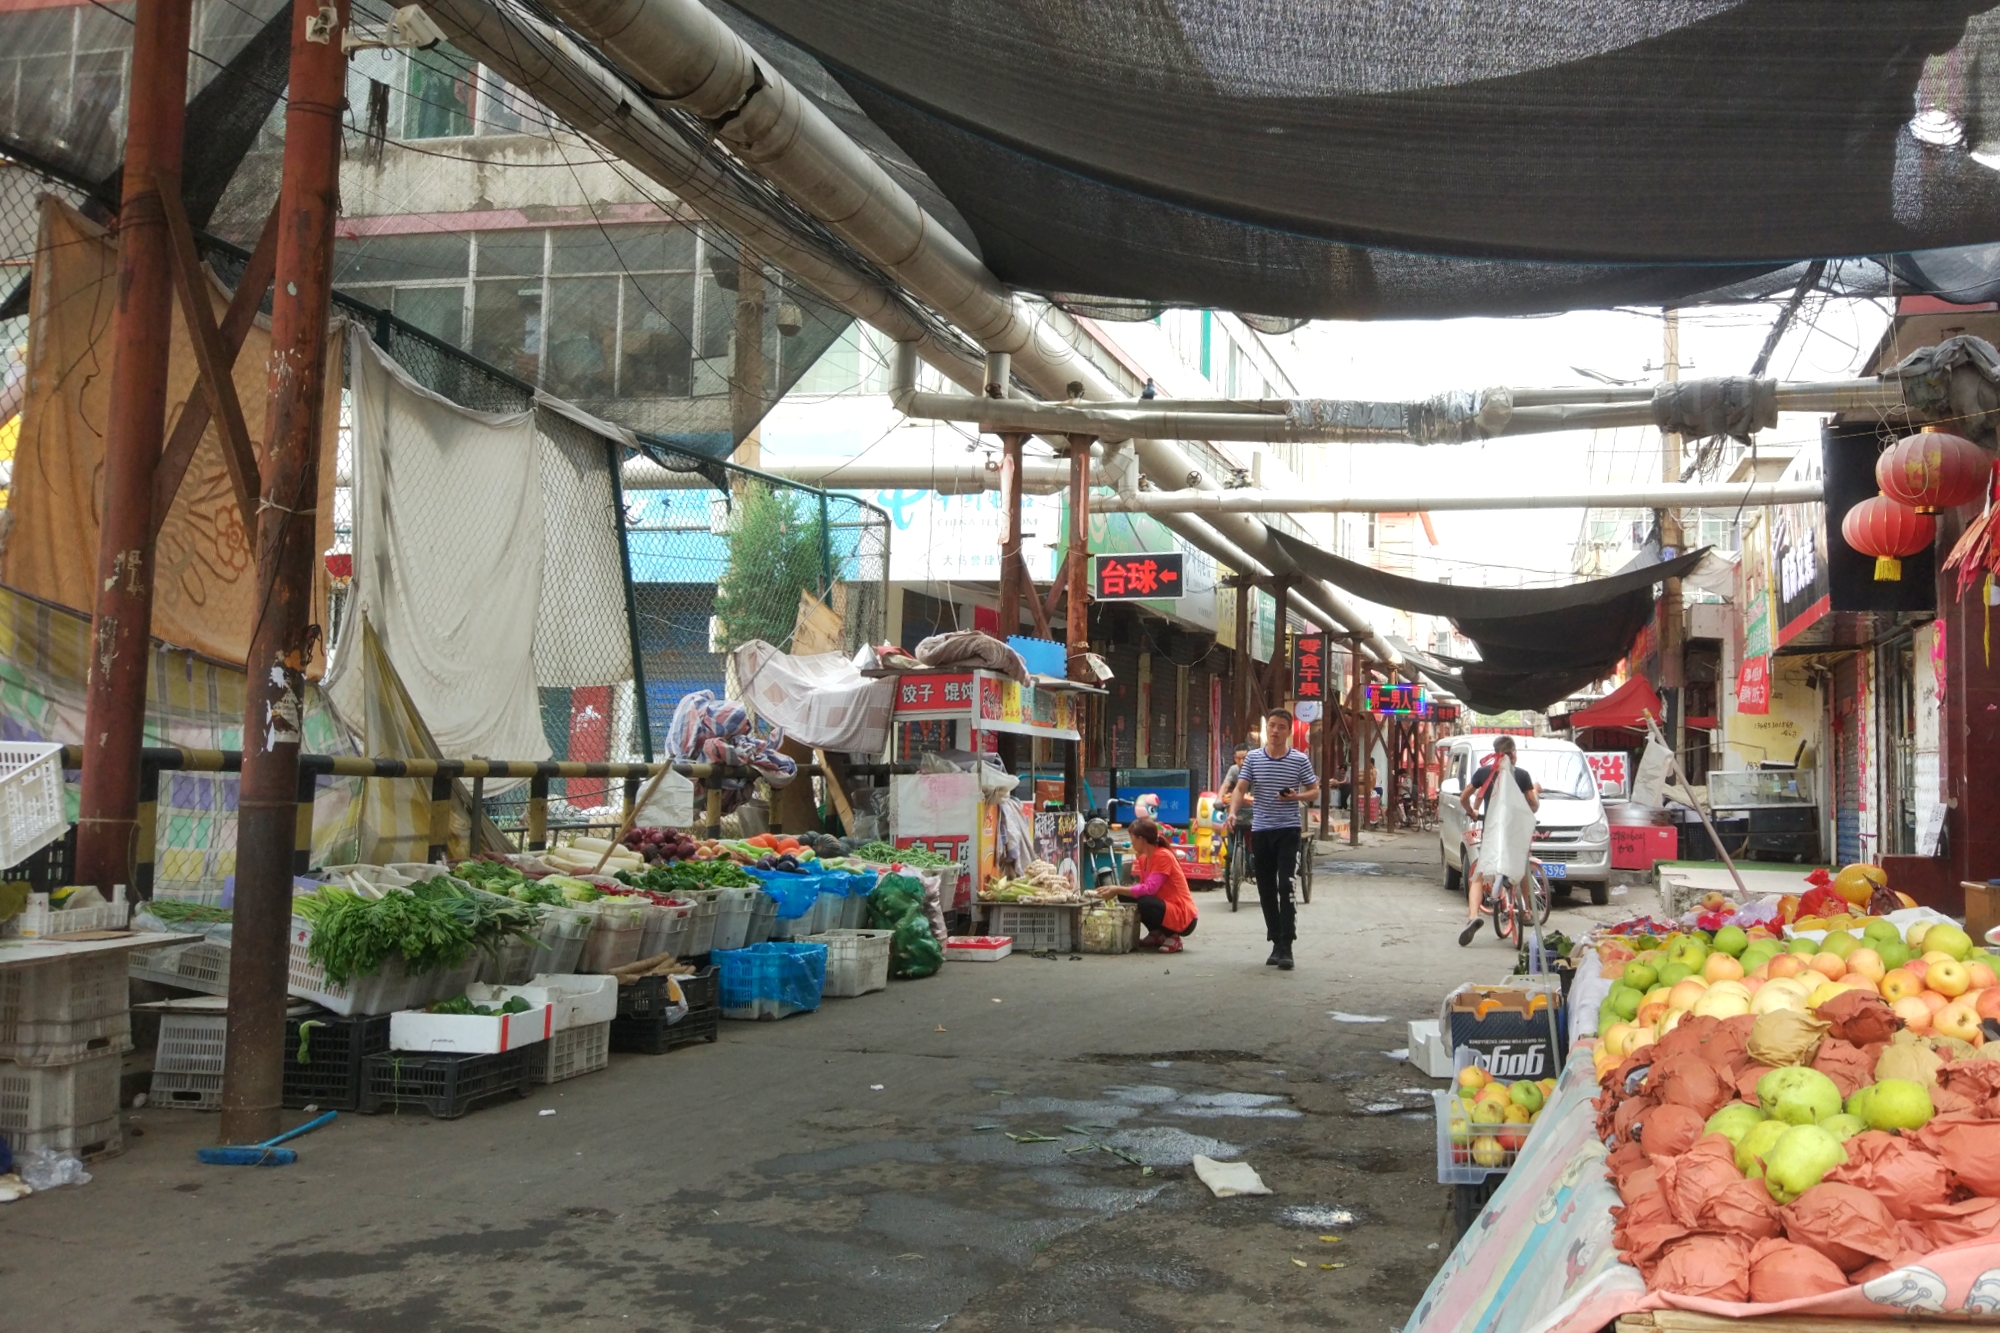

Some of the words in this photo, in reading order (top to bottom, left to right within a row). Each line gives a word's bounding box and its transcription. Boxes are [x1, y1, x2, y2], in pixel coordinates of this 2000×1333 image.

[1101, 559, 1158, 595] 台球
[1298, 638, 1322, 697] 零食干果
[901, 683, 935, 704] 饺子
[943, 681, 974, 702] 馄饨
[1369, 688, 1411, 710] 第一男人
